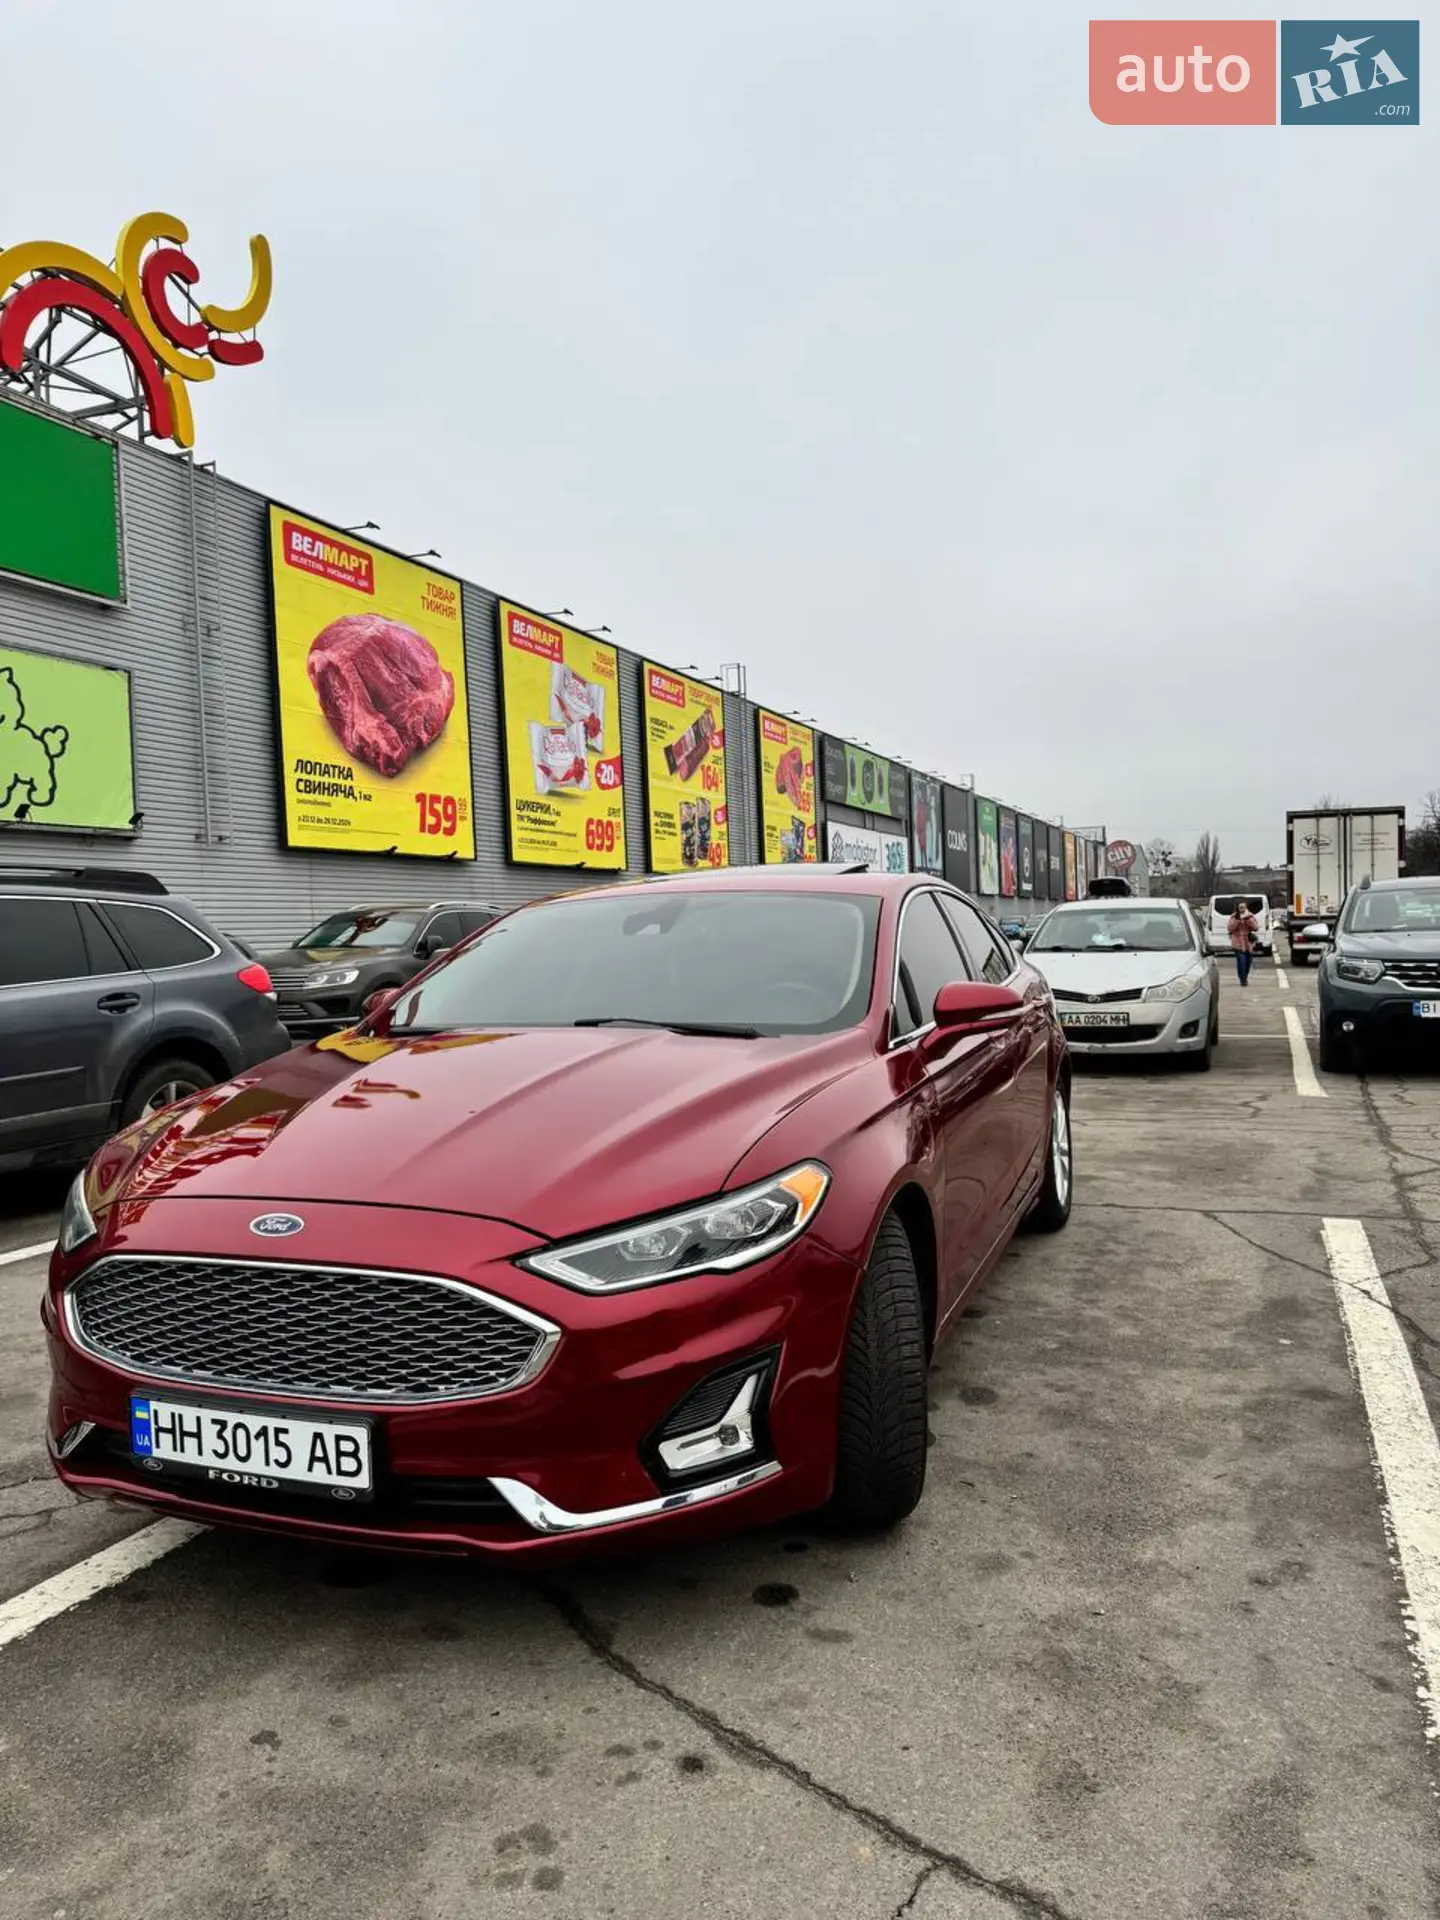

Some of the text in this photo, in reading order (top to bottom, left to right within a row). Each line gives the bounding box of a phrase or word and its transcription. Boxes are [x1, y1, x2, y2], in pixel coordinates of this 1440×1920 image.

[291, 531, 370, 577] ВЕЛМАРТ
[425, 581, 456, 604] ТОВАР
[420, 595, 457, 621] ТИЖНЯ!
[512, 618, 560, 651] ВЕЛМАРТ
[294, 758, 354, 781] ЛОПАТКА
[295, 778, 358, 802] СВИНЯЧА,
[415, 791, 457, 837] 159
[586, 817, 615, 853] 699
[1067, 1015, 1081, 1025] AA
[1084, 1015, 1108, 1025] 0204
[1421, 1003, 1437, 1014] BI
[260, 1217, 293, 1231] Ford
[136, 1434, 150, 1447] UA
[153, 1409, 363, 1478] HH 3015 AB
[208, 1469, 280, 1489] FORD
